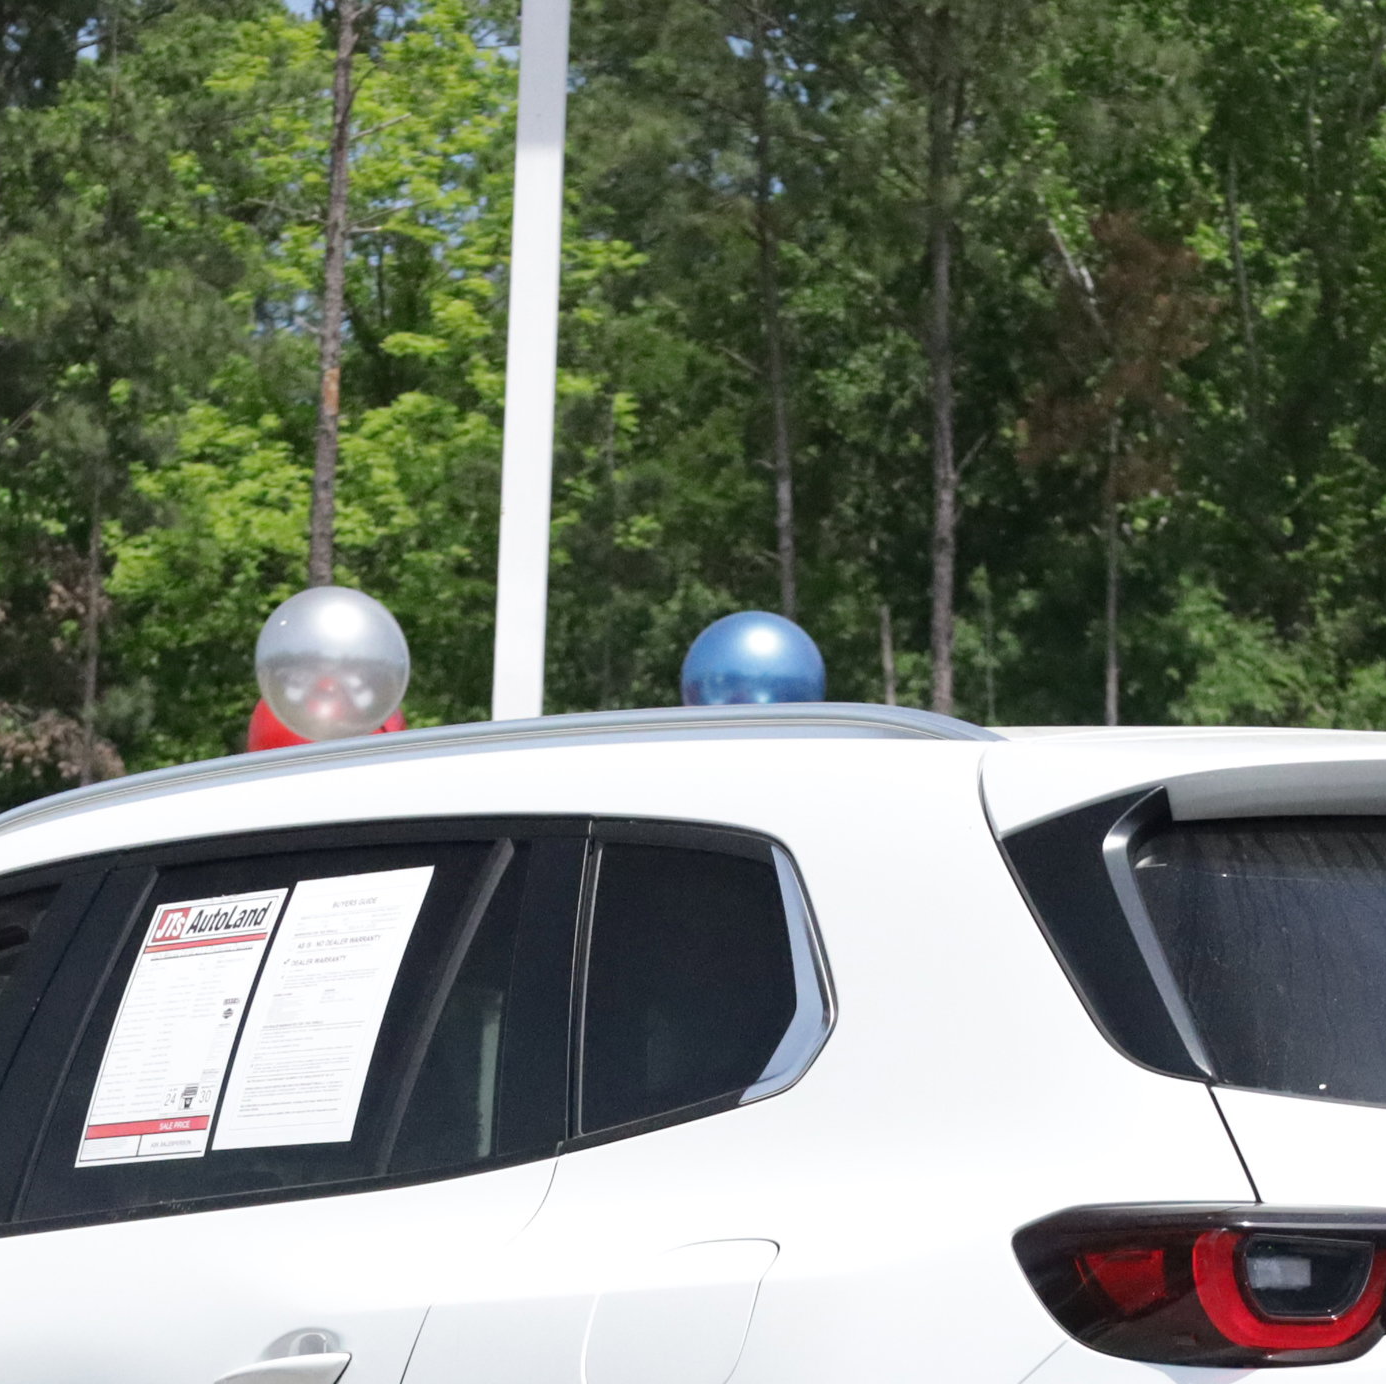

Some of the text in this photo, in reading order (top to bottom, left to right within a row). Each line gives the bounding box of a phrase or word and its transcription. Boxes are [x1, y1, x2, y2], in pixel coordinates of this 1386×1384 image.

[332, 897, 378, 908] BUYERS GUIDE
[155, 911, 186, 939] JTs
[186, 901, 273, 935] AutoLand
[164, 1092, 177, 1106] 24
[199, 1090, 212, 1104] 30
[159, 1120, 191, 1130] SALE PRICE
